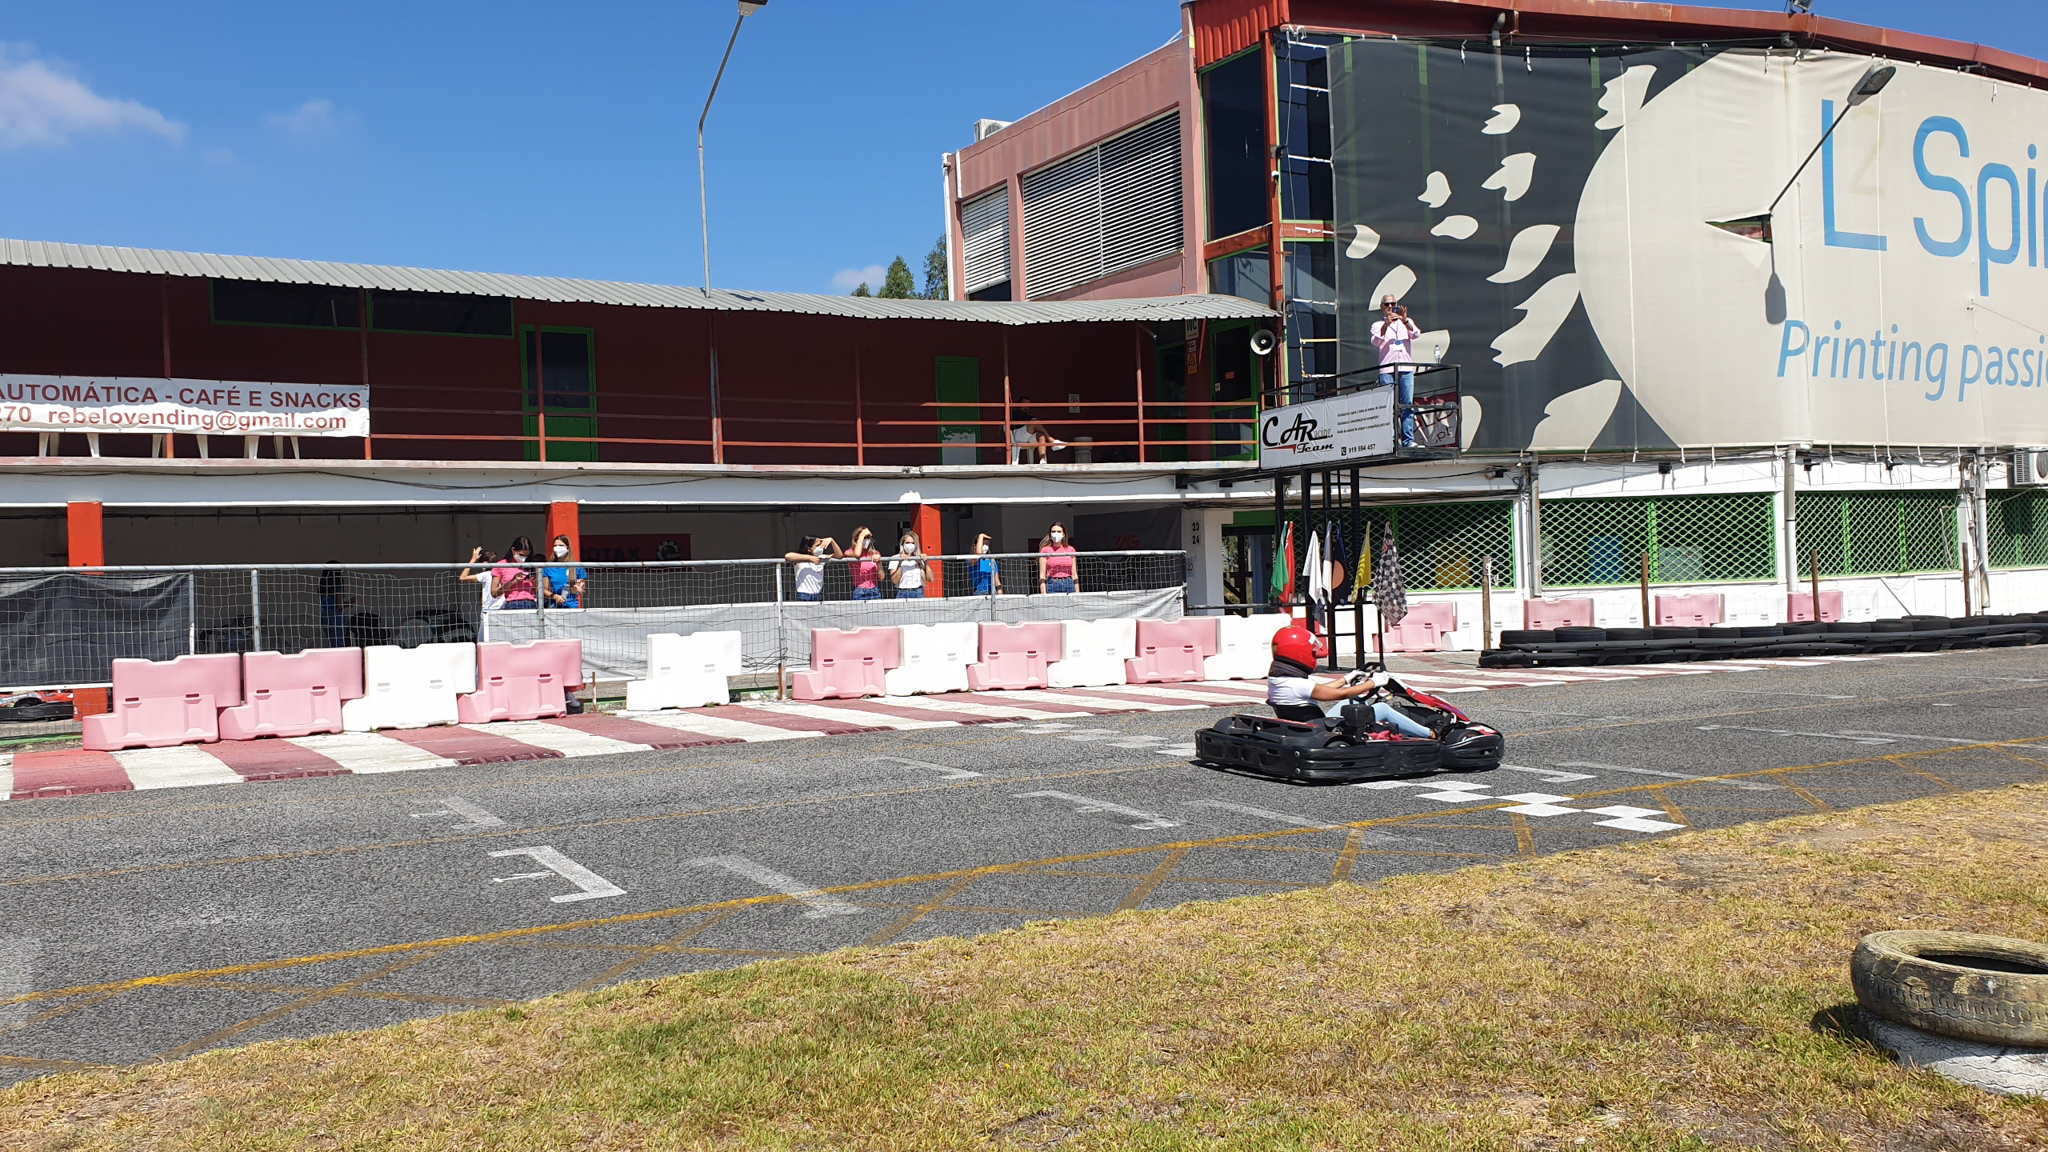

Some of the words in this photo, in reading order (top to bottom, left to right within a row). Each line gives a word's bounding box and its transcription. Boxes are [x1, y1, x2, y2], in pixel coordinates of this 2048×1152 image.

[1913, 115, 2048, 297] Spi
[1186, 318, 1197, 331] WC
[1777, 320, 1949, 402] Printing
[1958, 334, 2048, 402] passi
[179, 386, 241, 407] CAFÉ
[249, 391, 262, 407] E
[270, 391, 362, 408] SNACKS
[0, 406, 32, 423] 70
[49, 407, 347, 431] rebelovending@gmail.com
[1297, 442, 1334, 454] Team
[1192, 522, 1200, 531] 23
[1192, 535, 1200, 545] 24
